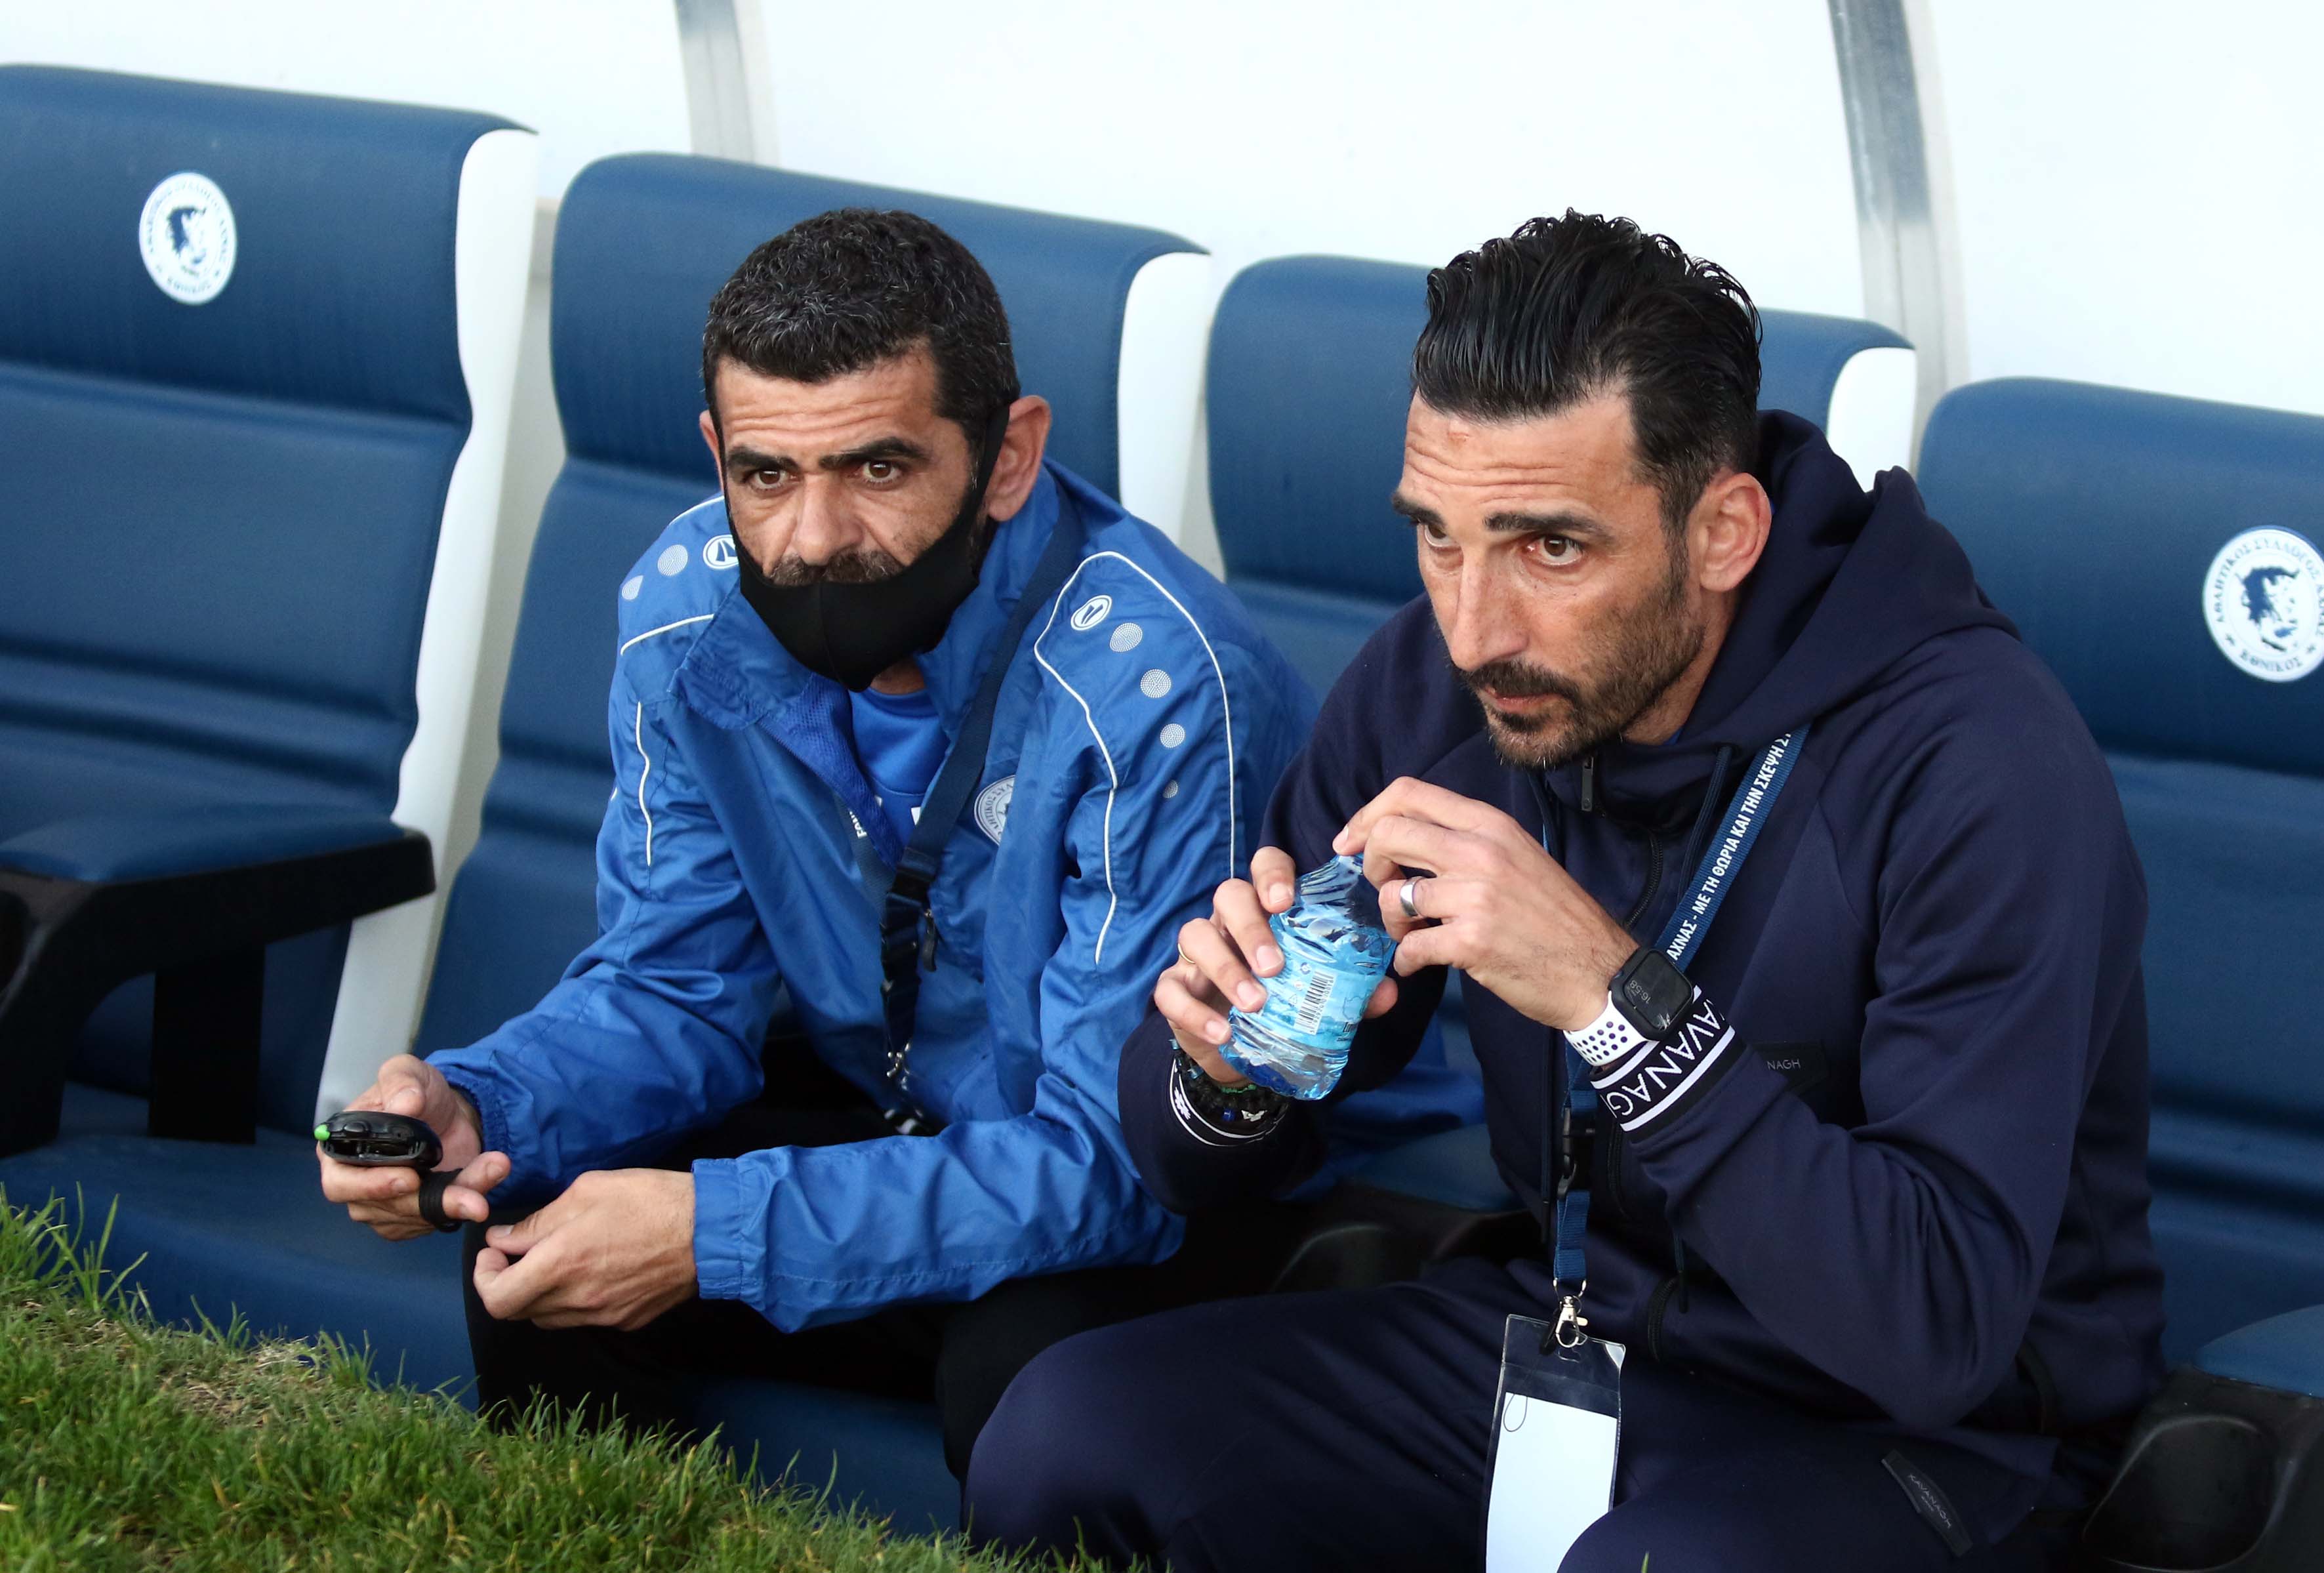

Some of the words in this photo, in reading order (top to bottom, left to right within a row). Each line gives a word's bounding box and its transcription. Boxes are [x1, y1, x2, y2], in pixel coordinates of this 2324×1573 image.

[1753, 745, 1785, 790] ΣΚΕΨΗ
[1740, 787, 1764, 814] ΤΗΝ
[1730, 814, 1751, 838] ΚΑΙ
[1711, 838, 1740, 877] ΘΩΡΙΑ
[1702, 876, 1720, 893] ΤΗ
[1692, 893, 1711, 915] ΜΕ
[1666, 920, 1698, 961] ΑΧΝΑΣ
[1630, 980, 1652, 1004] 16:58
[1766, 1059, 1801, 1070] NAGH
